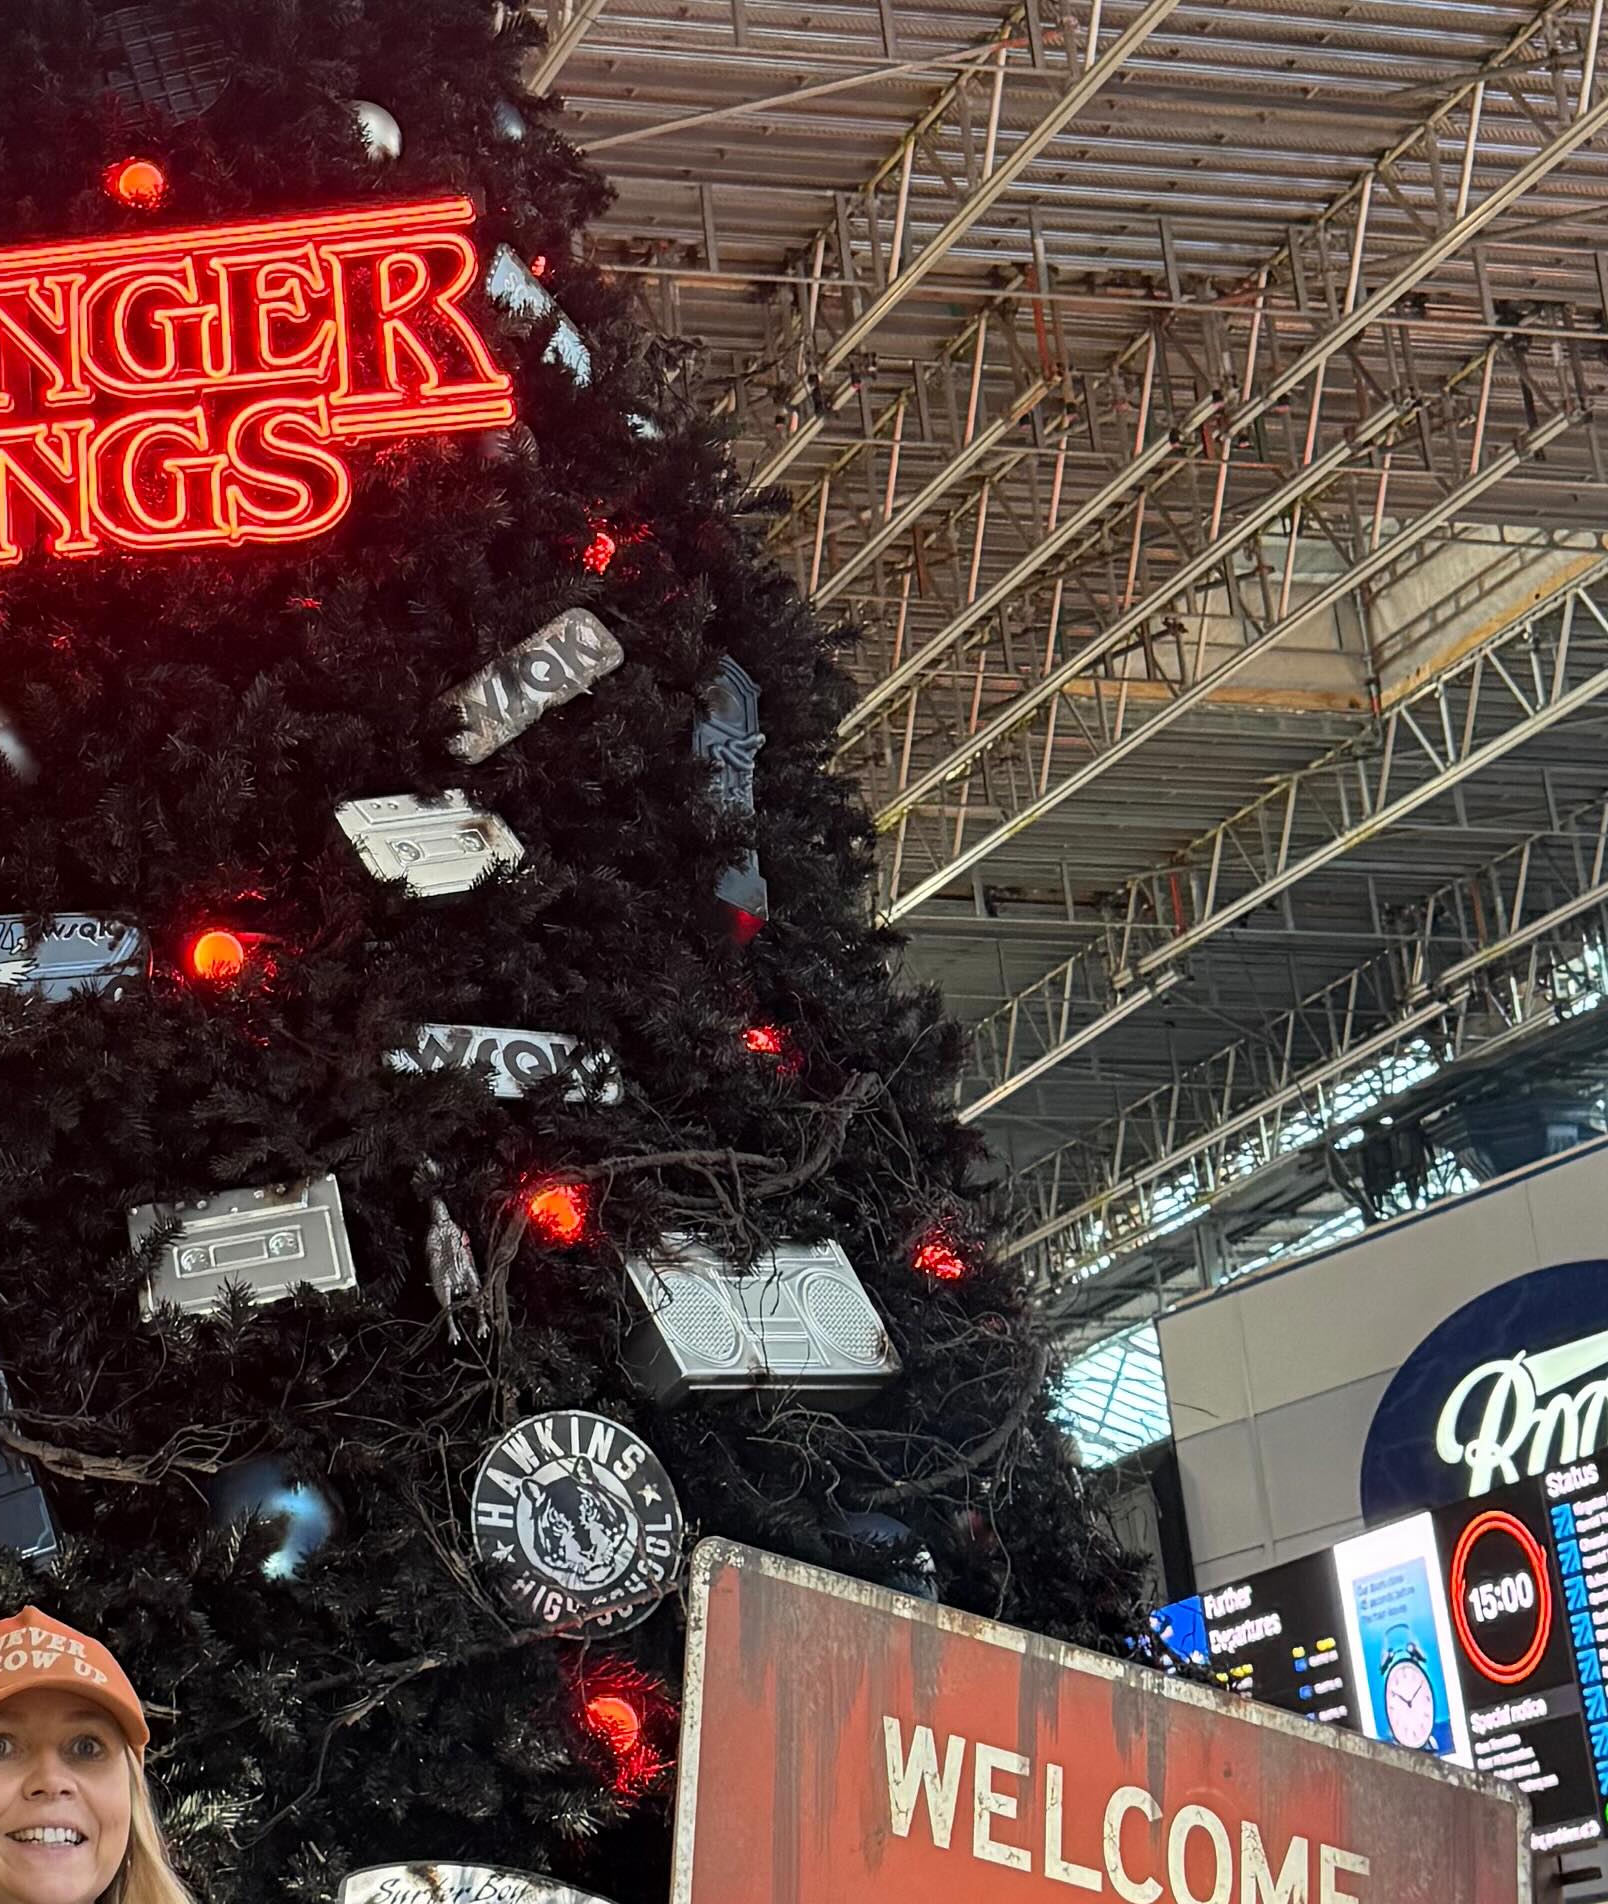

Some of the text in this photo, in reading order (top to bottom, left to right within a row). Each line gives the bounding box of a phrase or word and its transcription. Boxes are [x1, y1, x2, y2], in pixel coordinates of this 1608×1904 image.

[477, 1416, 646, 1529] HAWKINS
[1545, 1462, 1600, 1498] Status
[1203, 1585, 1252, 1619] Further
[1468, 1571, 1534, 1623] 15:00
[1208, 1612, 1283, 1655] Departures
[72, 1657, 109, 1685] UP
